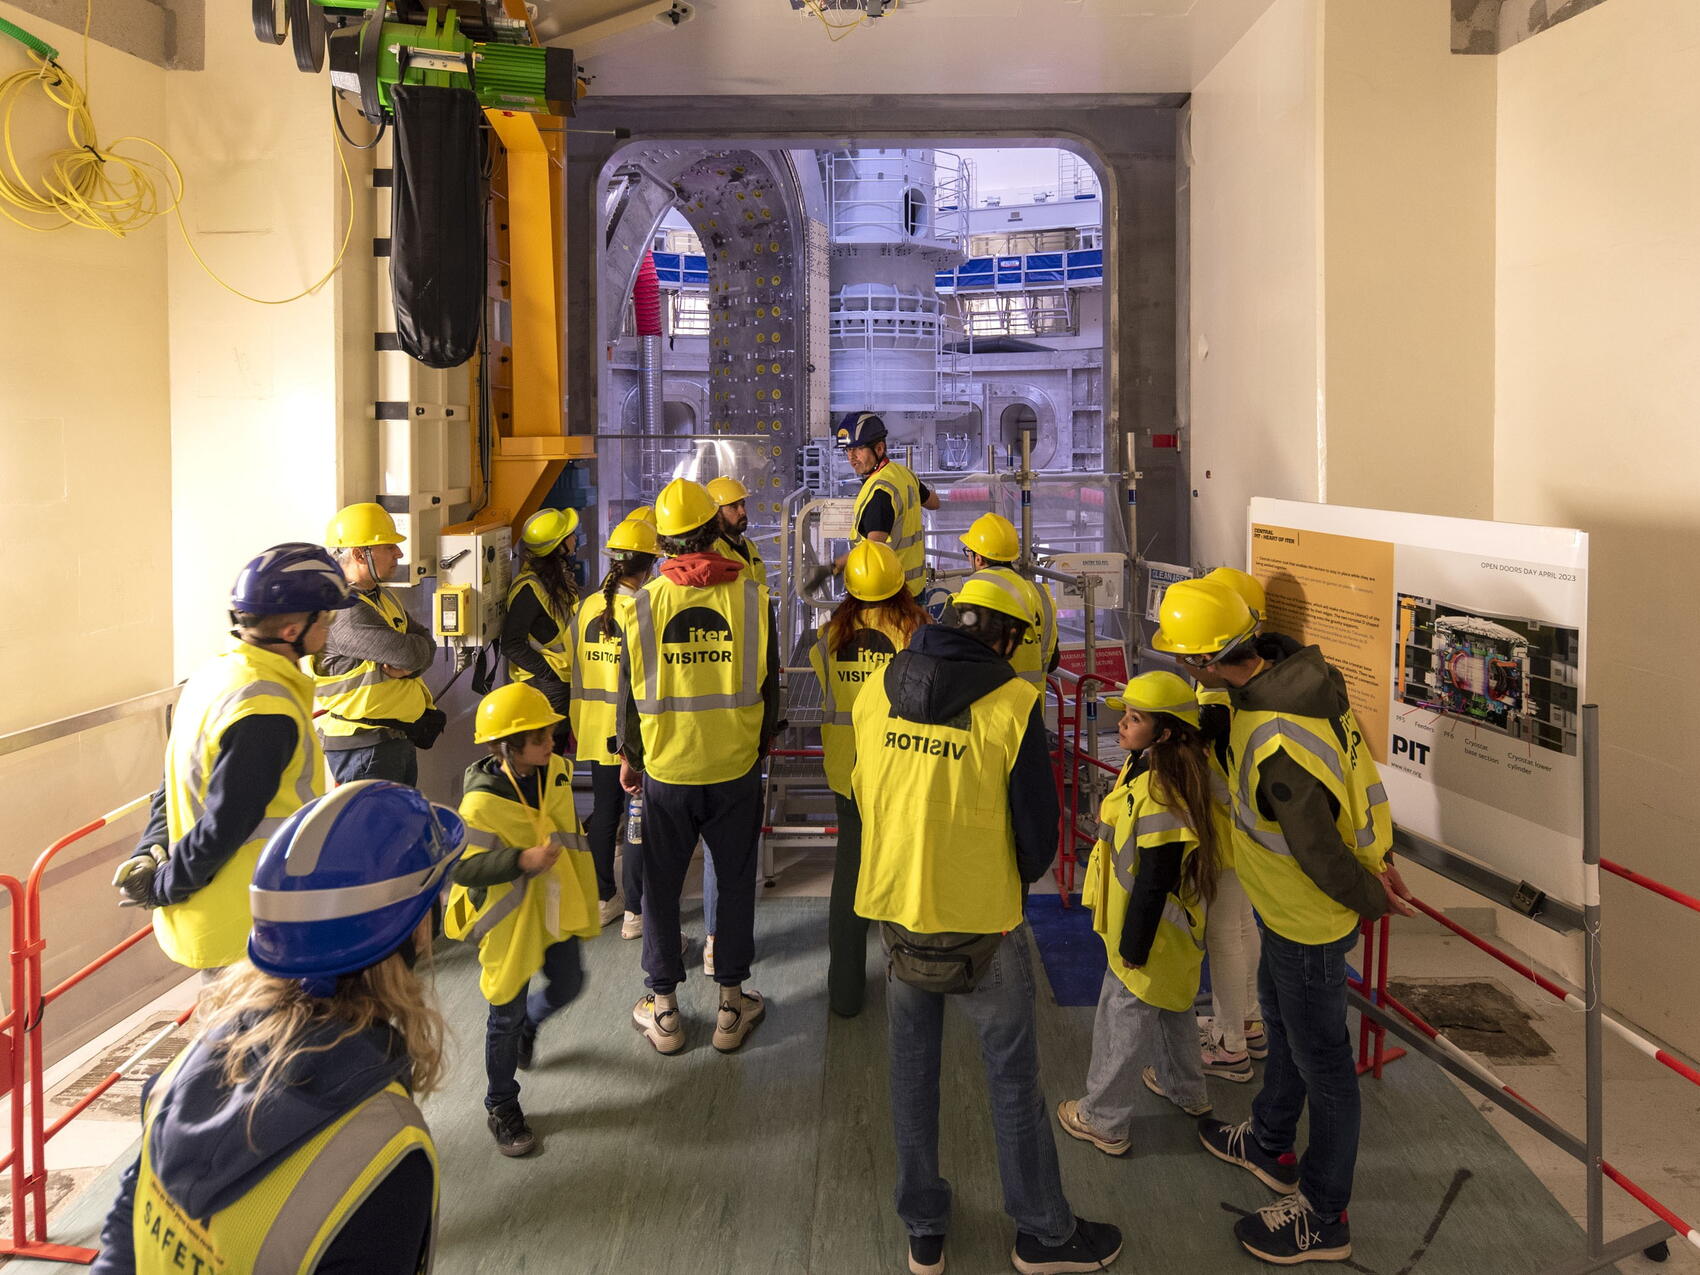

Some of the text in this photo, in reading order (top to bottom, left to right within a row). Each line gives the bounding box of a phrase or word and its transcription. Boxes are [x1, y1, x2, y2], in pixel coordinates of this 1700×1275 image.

[1152, 570, 1171, 581] CLEAN
[1480, 561, 1577, 582] OPEN DOORS DAY APRIL 2023
[689, 627, 729, 642] iter
[663, 650, 732, 664] VISITOR
[857, 647, 894, 664] iter
[837, 670, 872, 682] VISIT
[1415, 721, 1435, 733] Feeders
[1392, 733, 1431, 766] PIT
[1464, 738, 1489, 752] Cryostat
[1464, 747, 1500, 765] base section
[1507, 752, 1553, 772] Cryostat lower
[1507, 763, 1532, 775] cylinder
